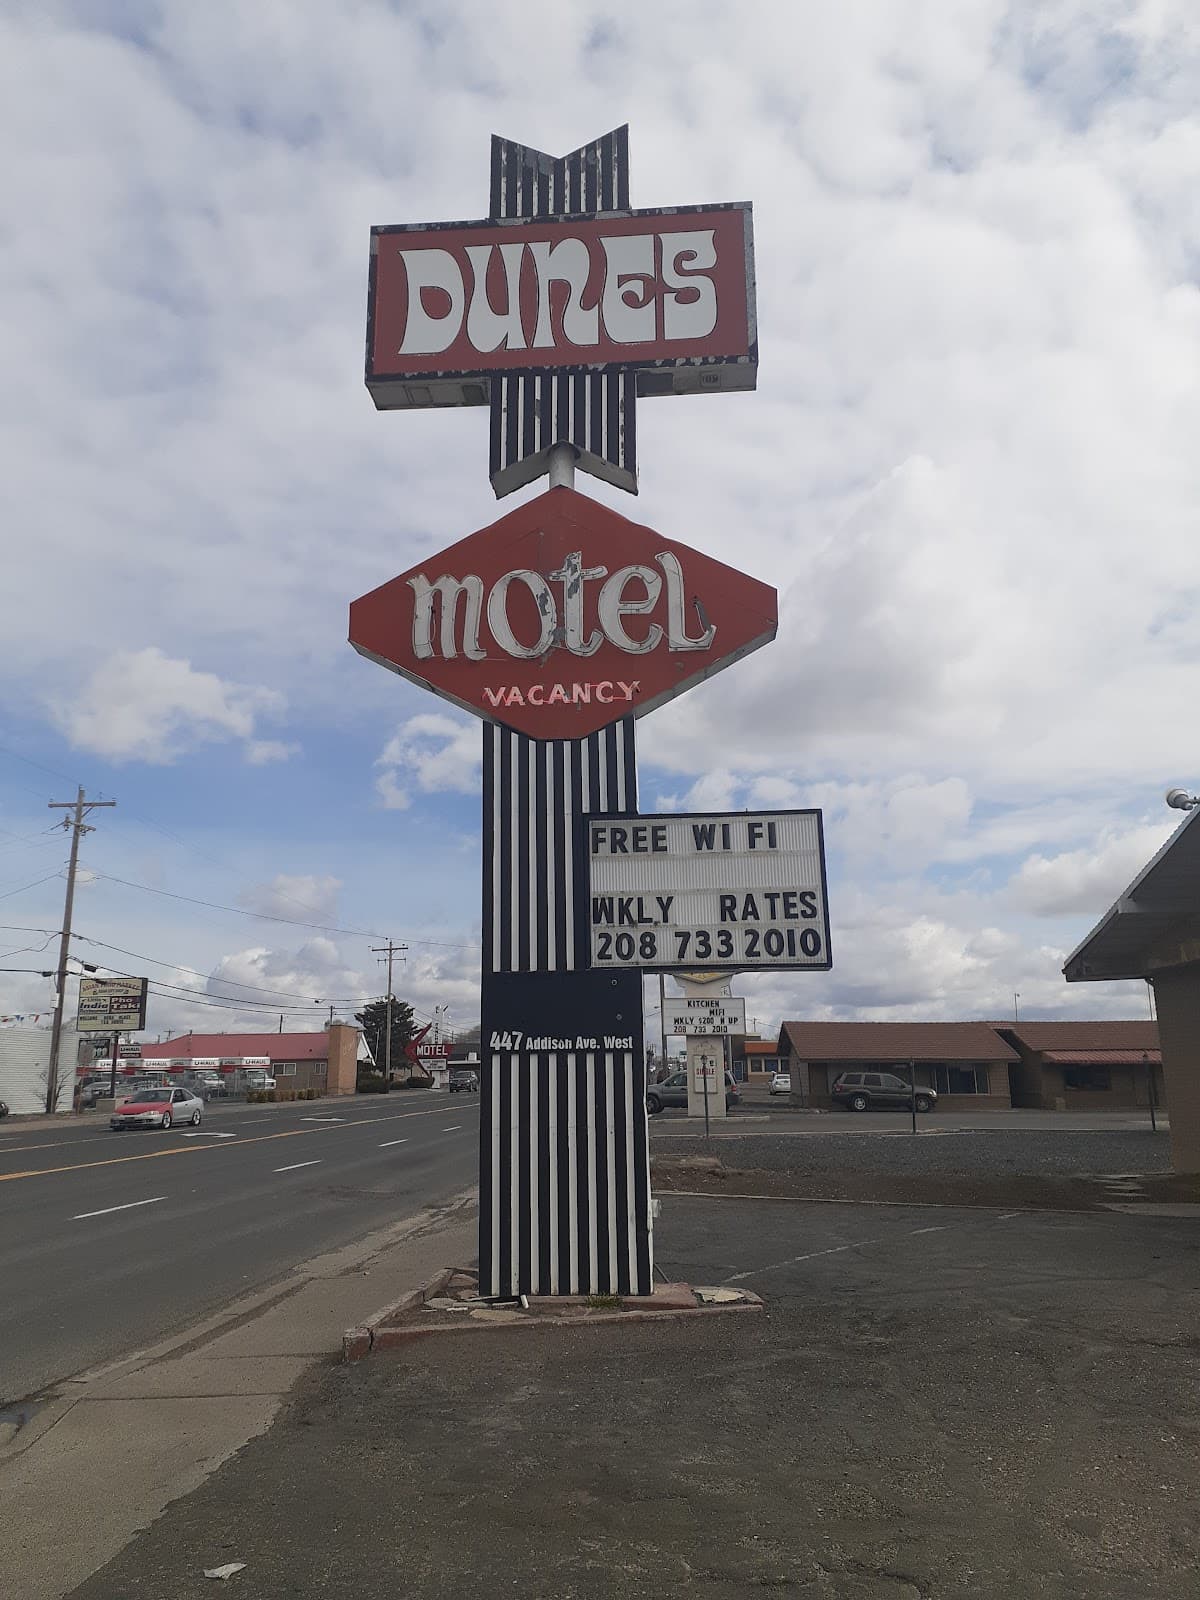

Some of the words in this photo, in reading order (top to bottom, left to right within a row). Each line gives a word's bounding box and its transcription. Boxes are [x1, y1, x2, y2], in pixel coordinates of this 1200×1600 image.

[398, 229, 718, 356] DUNES
[484, 680, 641, 707] VACANCY
[592, 825, 668, 854] FREE
[592, 895, 674, 924] WKLY
[719, 891, 818, 922] RATES
[596, 931, 658, 961] 208
[674, 929, 734, 959] 733
[744, 928, 822, 957] 2010
[687, 1000, 720, 1008] KITCHEN
[489, 1031, 523, 1051] 447
[525, 1037, 572, 1050] Addison
[575, 1036, 601, 1049] Ave.
[603, 1036, 633, 1049] West
[694, 1025, 707, 1033] 733
[712, 1025, 728, 1033] 2010
[416, 1045, 448, 1056] MOTEL
